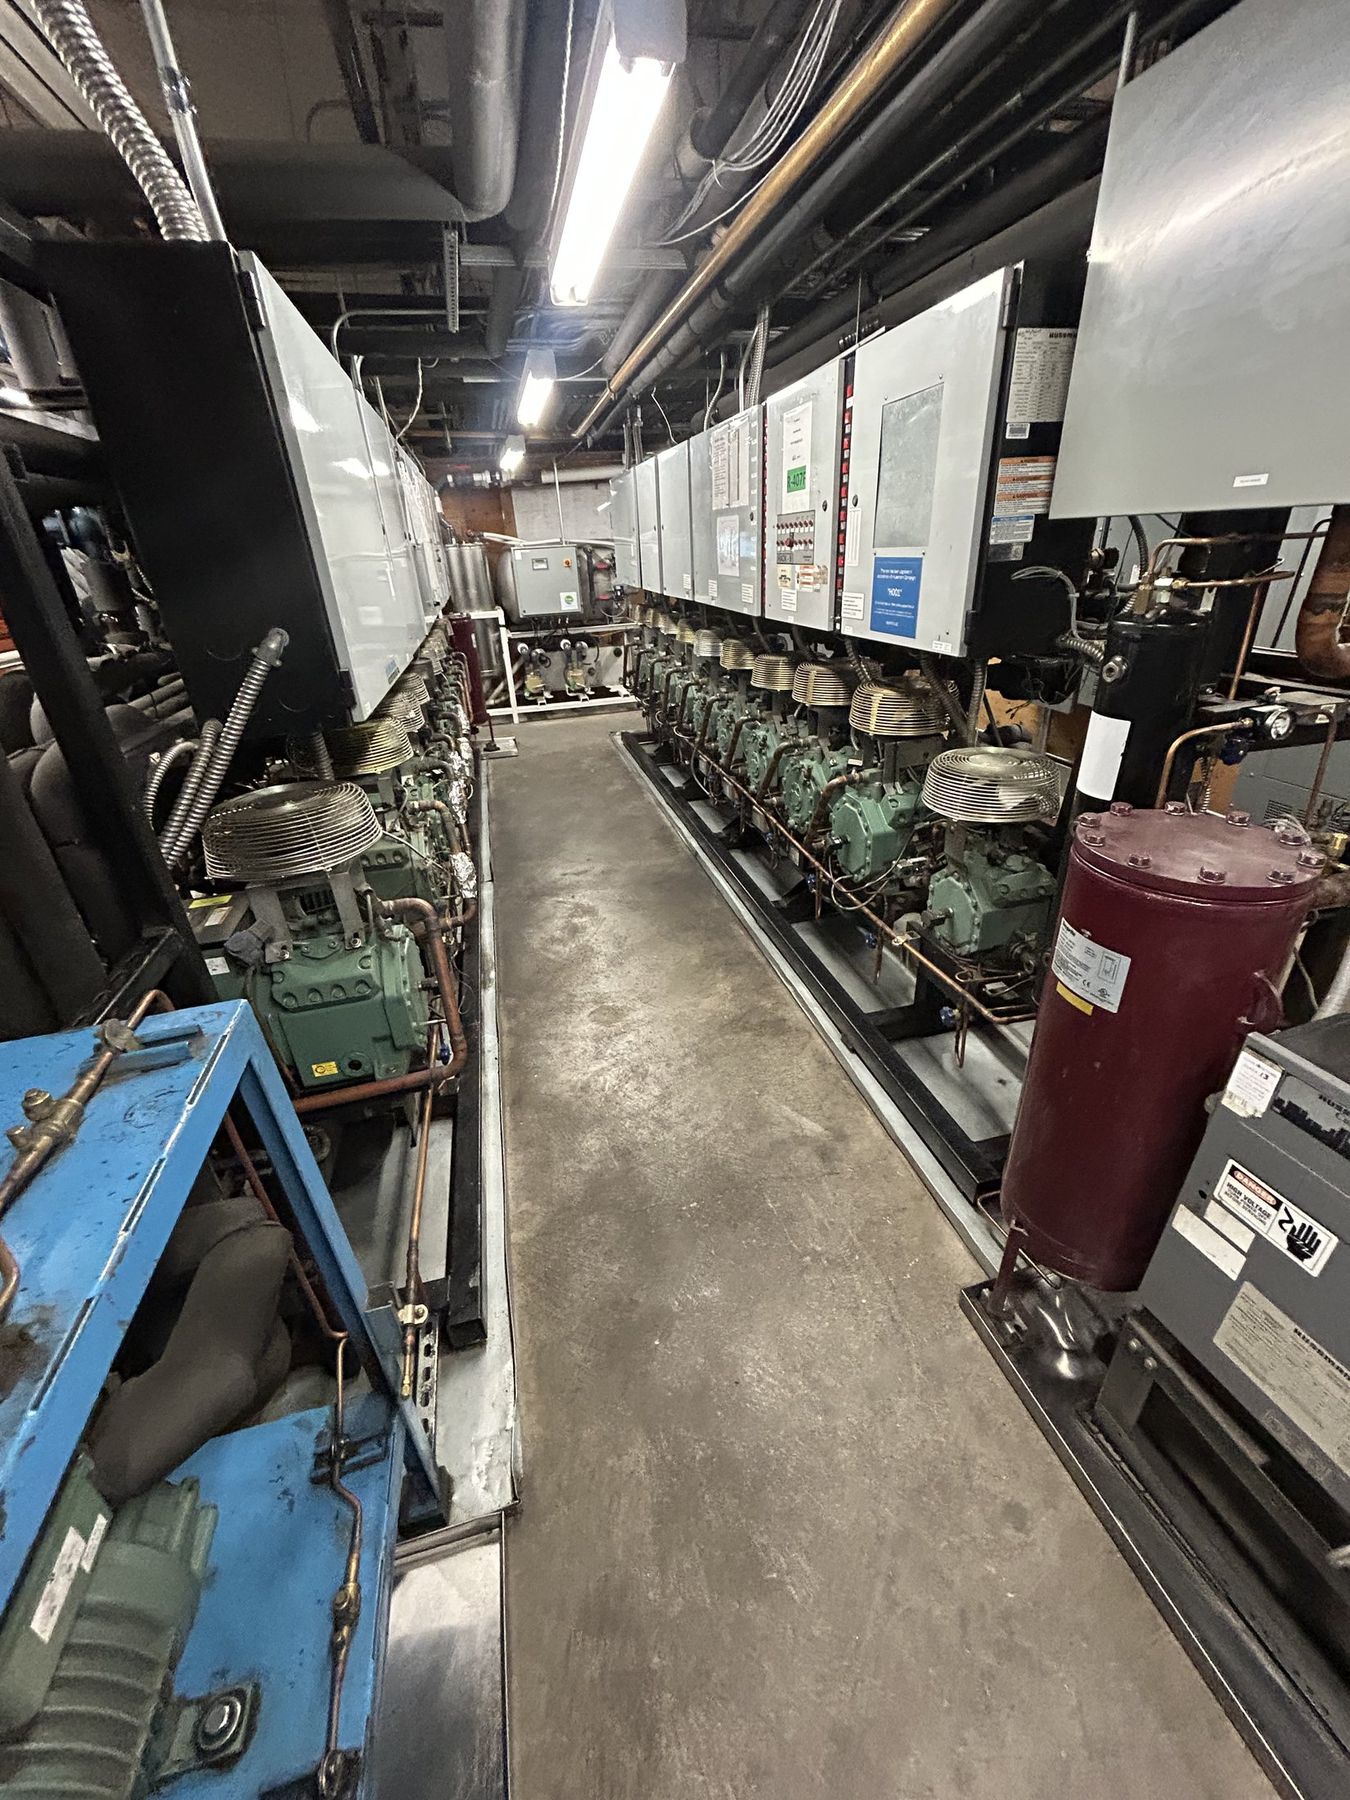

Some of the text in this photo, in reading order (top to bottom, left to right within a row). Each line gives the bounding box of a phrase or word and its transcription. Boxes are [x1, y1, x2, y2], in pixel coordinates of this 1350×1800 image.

[1226, 1181, 1272, 1219] HIGH VOLTAGE
[1235, 1171, 1274, 1203] DANGER
